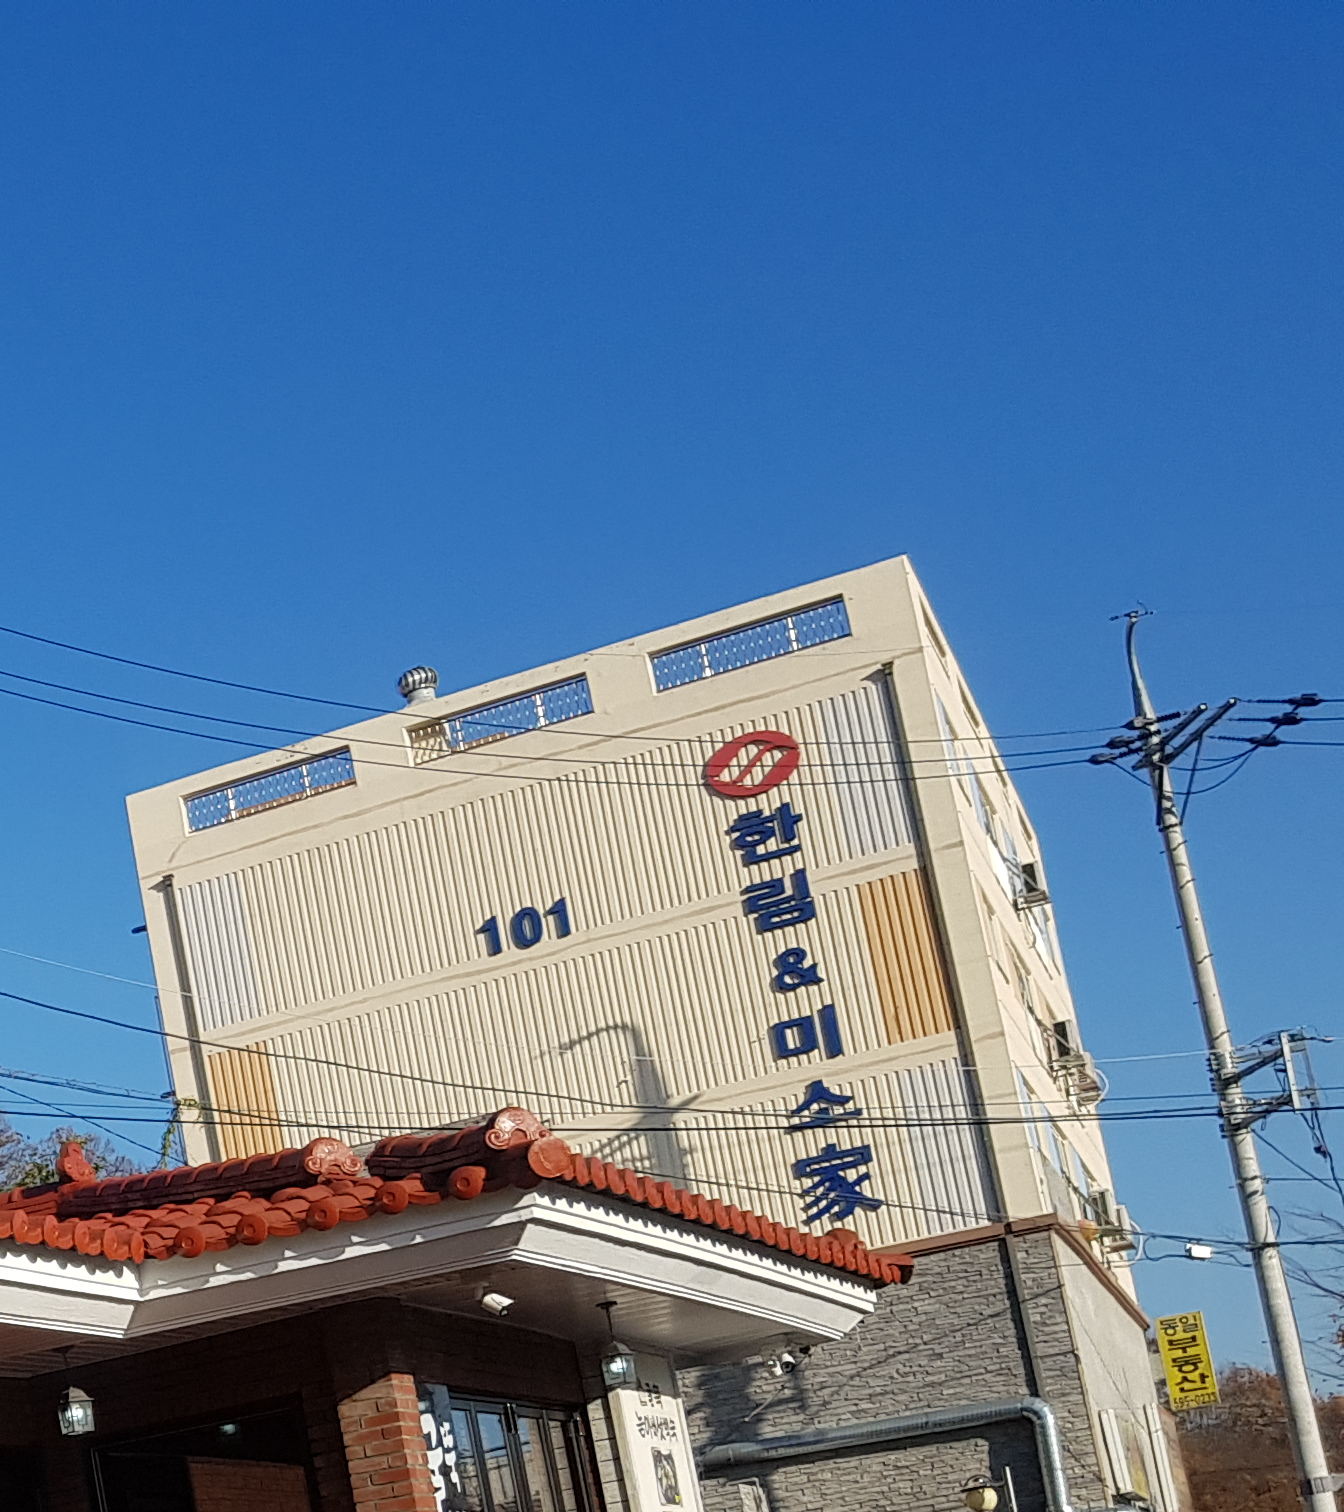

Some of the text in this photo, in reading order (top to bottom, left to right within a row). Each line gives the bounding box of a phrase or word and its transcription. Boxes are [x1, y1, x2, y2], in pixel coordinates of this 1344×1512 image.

[474, 897, 573, 957] 101
[1159, 1314, 1200, 1337] 동일
[1166, 1334, 1210, 1393] 부동산
